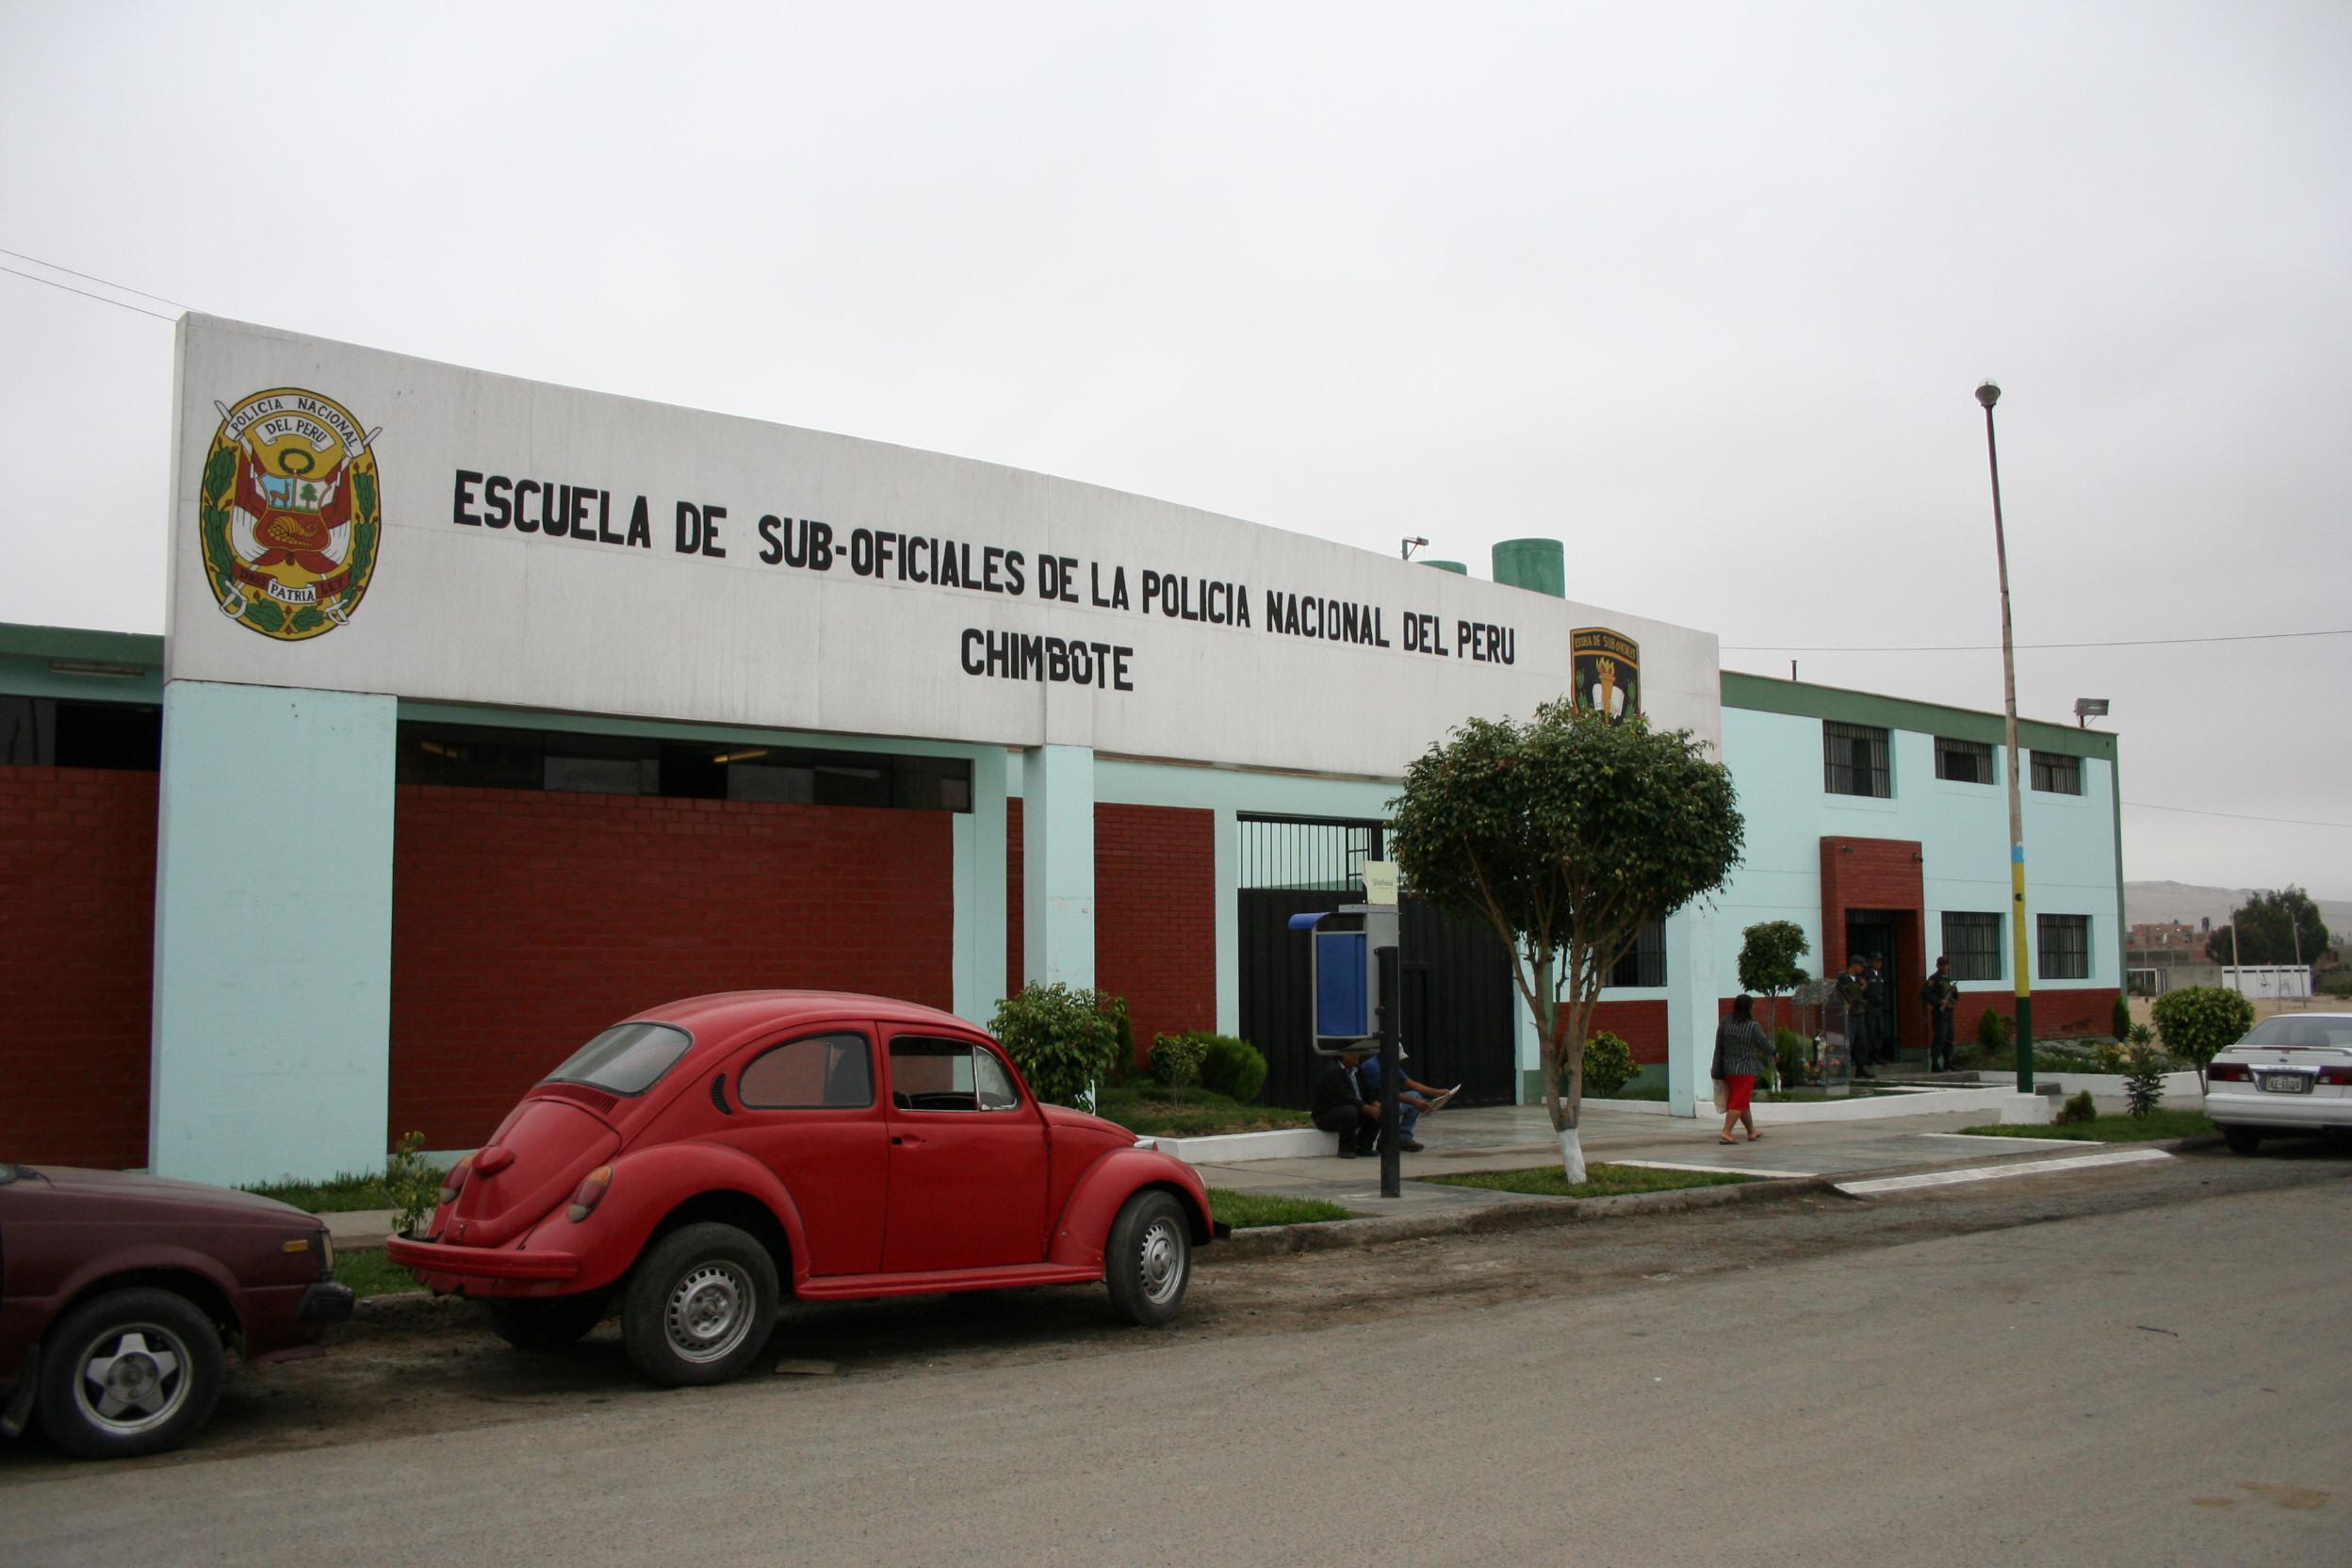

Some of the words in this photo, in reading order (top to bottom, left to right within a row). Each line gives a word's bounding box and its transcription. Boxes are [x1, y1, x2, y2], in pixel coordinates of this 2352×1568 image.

[231, 399, 284, 433] POLICIA
[297, 398, 358, 448] NACIONAL
[265, 418, 292, 434] DEL
[296, 419, 328, 443] PERU
[270, 583, 316, 601] PATRIA
[453, 469, 651, 548] ESCUELA
[676, 501, 727, 558] DE
[759, 514, 1025, 596] SUB-OFICIALES
[1038, 554, 1079, 603] DE
[1091, 562, 1129, 611] LA
[1142, 570, 1250, 628] POLICIA
[1266, 590, 1390, 647] NACIONAL
[1403, 612, 1448, 656] DEL
[1458, 620, 1515, 665] PERU
[961, 629, 1134, 692] CHIMBOTE
